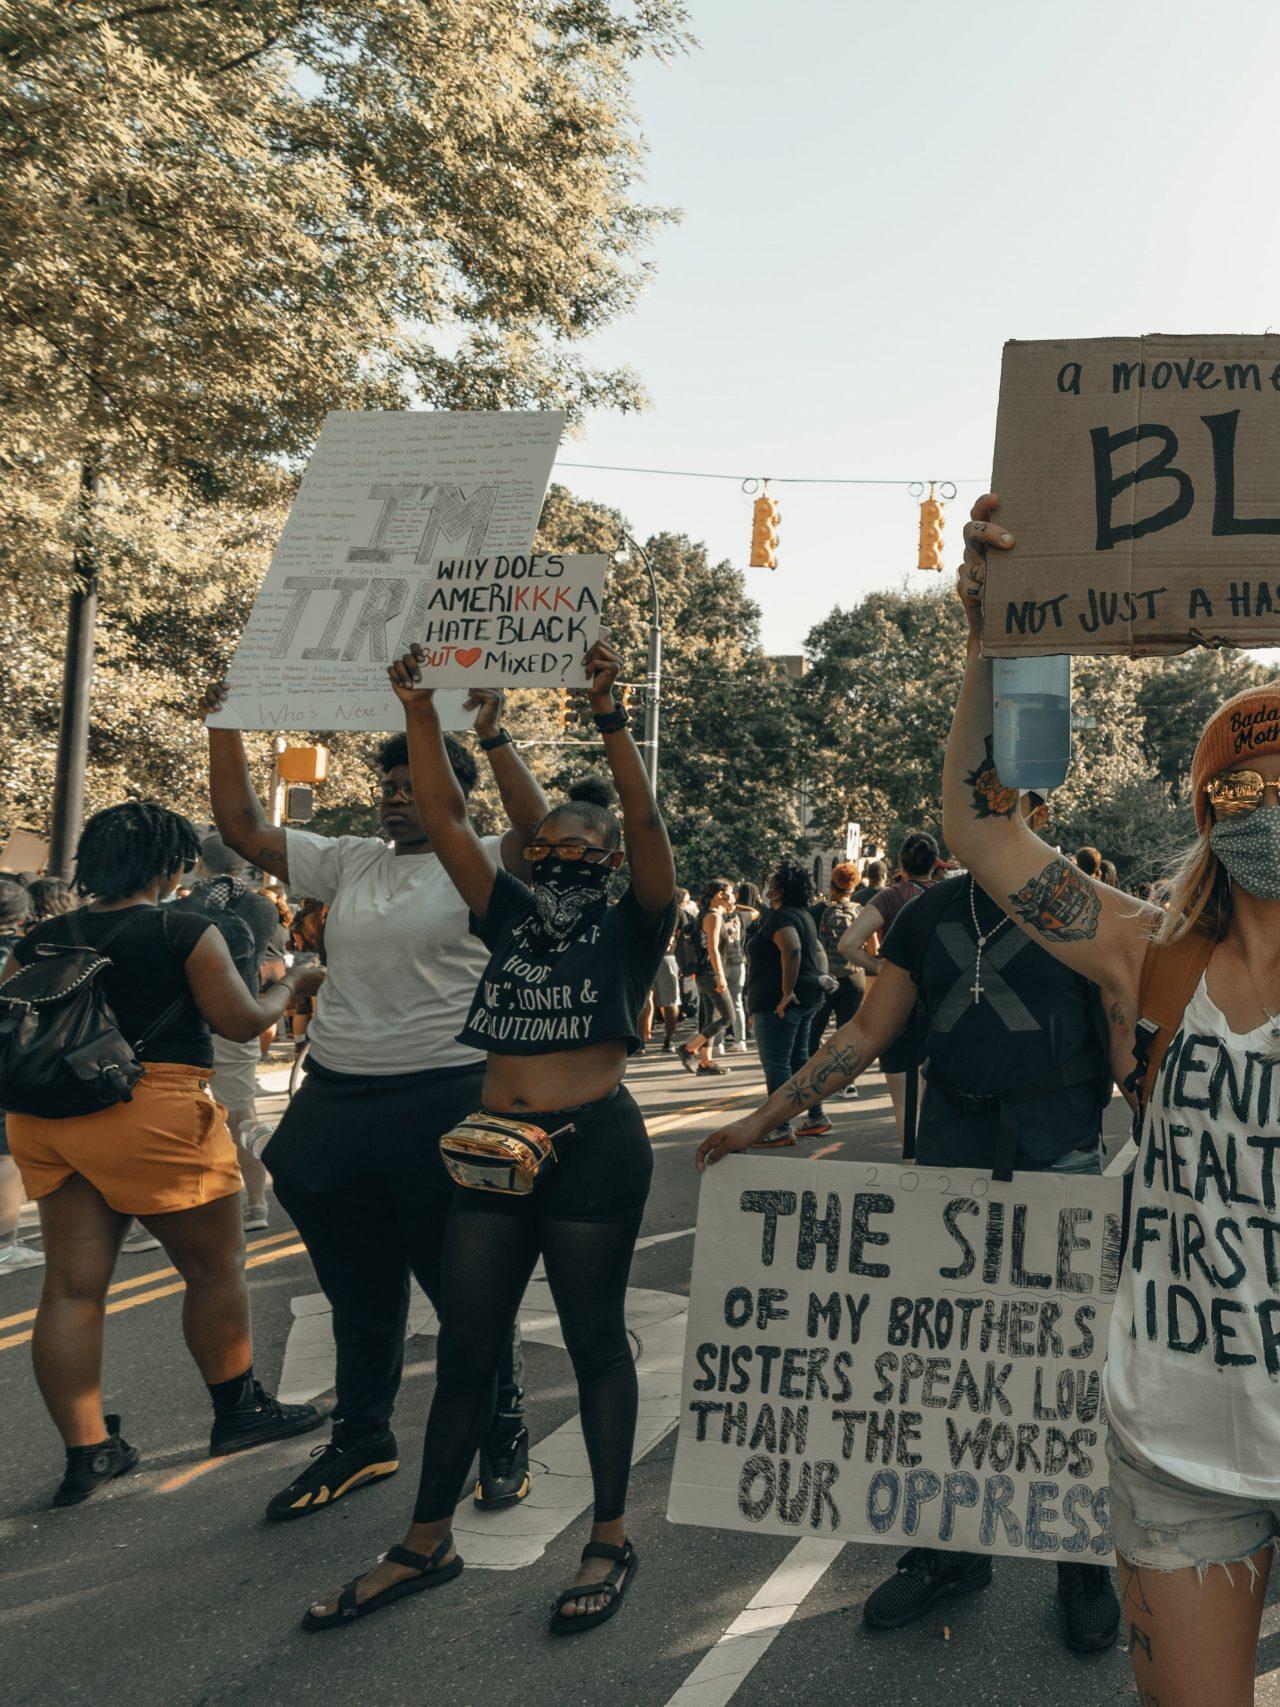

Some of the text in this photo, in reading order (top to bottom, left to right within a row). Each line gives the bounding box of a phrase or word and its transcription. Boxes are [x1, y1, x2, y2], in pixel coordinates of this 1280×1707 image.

[1057, 362, 1083, 395] a
[346, 485, 499, 565] I'M
[437, 555, 565, 581] WHY DOES
[427, 583, 600, 615] AMERIKKKA
[1005, 593, 1070, 635] NOT
[1078, 587, 1169, 634] JUST
[1188, 587, 1214, 619] A
[426, 615, 589, 653] HATE BLACK
[258, 702, 319, 727] Who's
[516, 985, 573, 1011] LONER
[580, 978, 599, 1004] &
[740, 1190, 896, 1279] THE
[724, 1285, 1097, 1359] OF MY BROTHERS
[692, 1342, 1109, 1426] SISTERS SPEAK LOU
[689, 1400, 1098, 1479] THAN THE WORDS
[737, 1453, 842, 1533] OUR
